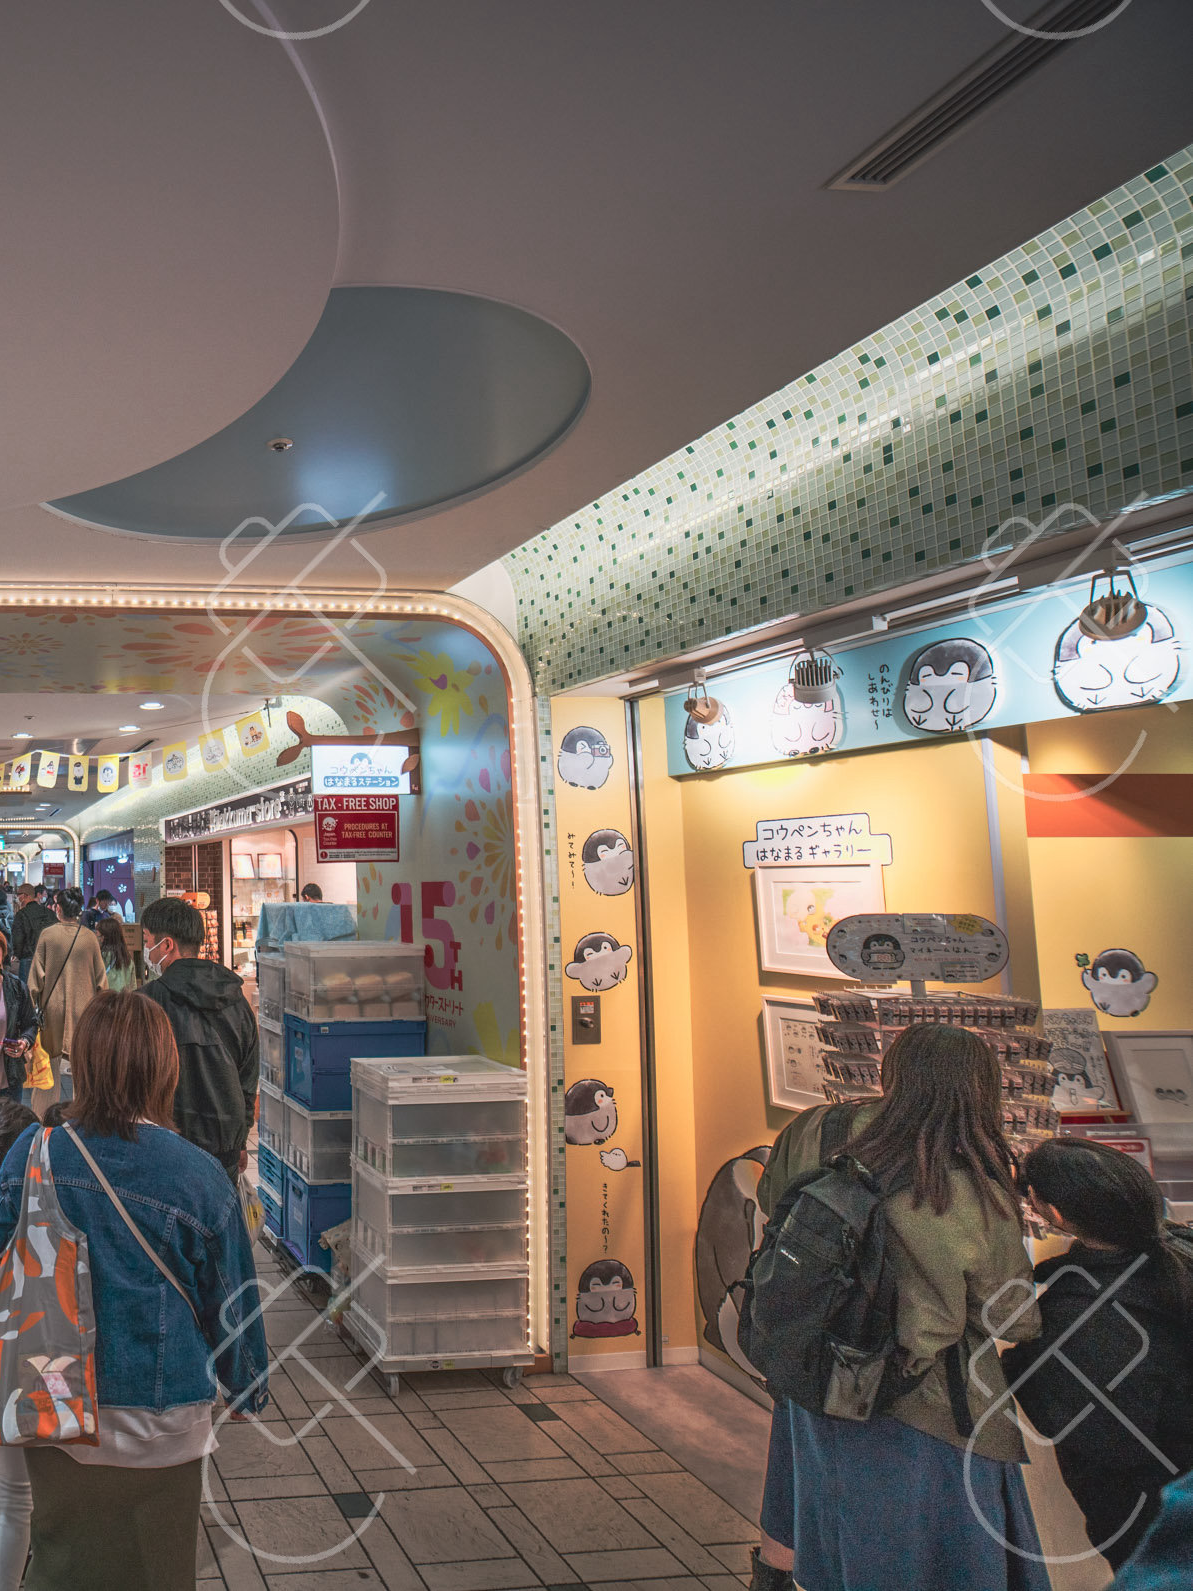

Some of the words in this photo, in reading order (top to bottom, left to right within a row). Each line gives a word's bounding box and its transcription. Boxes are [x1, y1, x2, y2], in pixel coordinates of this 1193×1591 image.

[879, 663, 893, 718] のんびりは
[329, 765, 393, 775] コウペンちゃん
[324, 777, 399, 787] はなまるステーション
[255, 796, 282, 823] store
[316, 798, 337, 810] TAX
[343, 797, 367, 810] FREE
[369, 797, 397, 810] SHOP
[762, 820, 863, 842] コウペンちゃん
[756, 844, 872, 862] はなまるギャラリー
